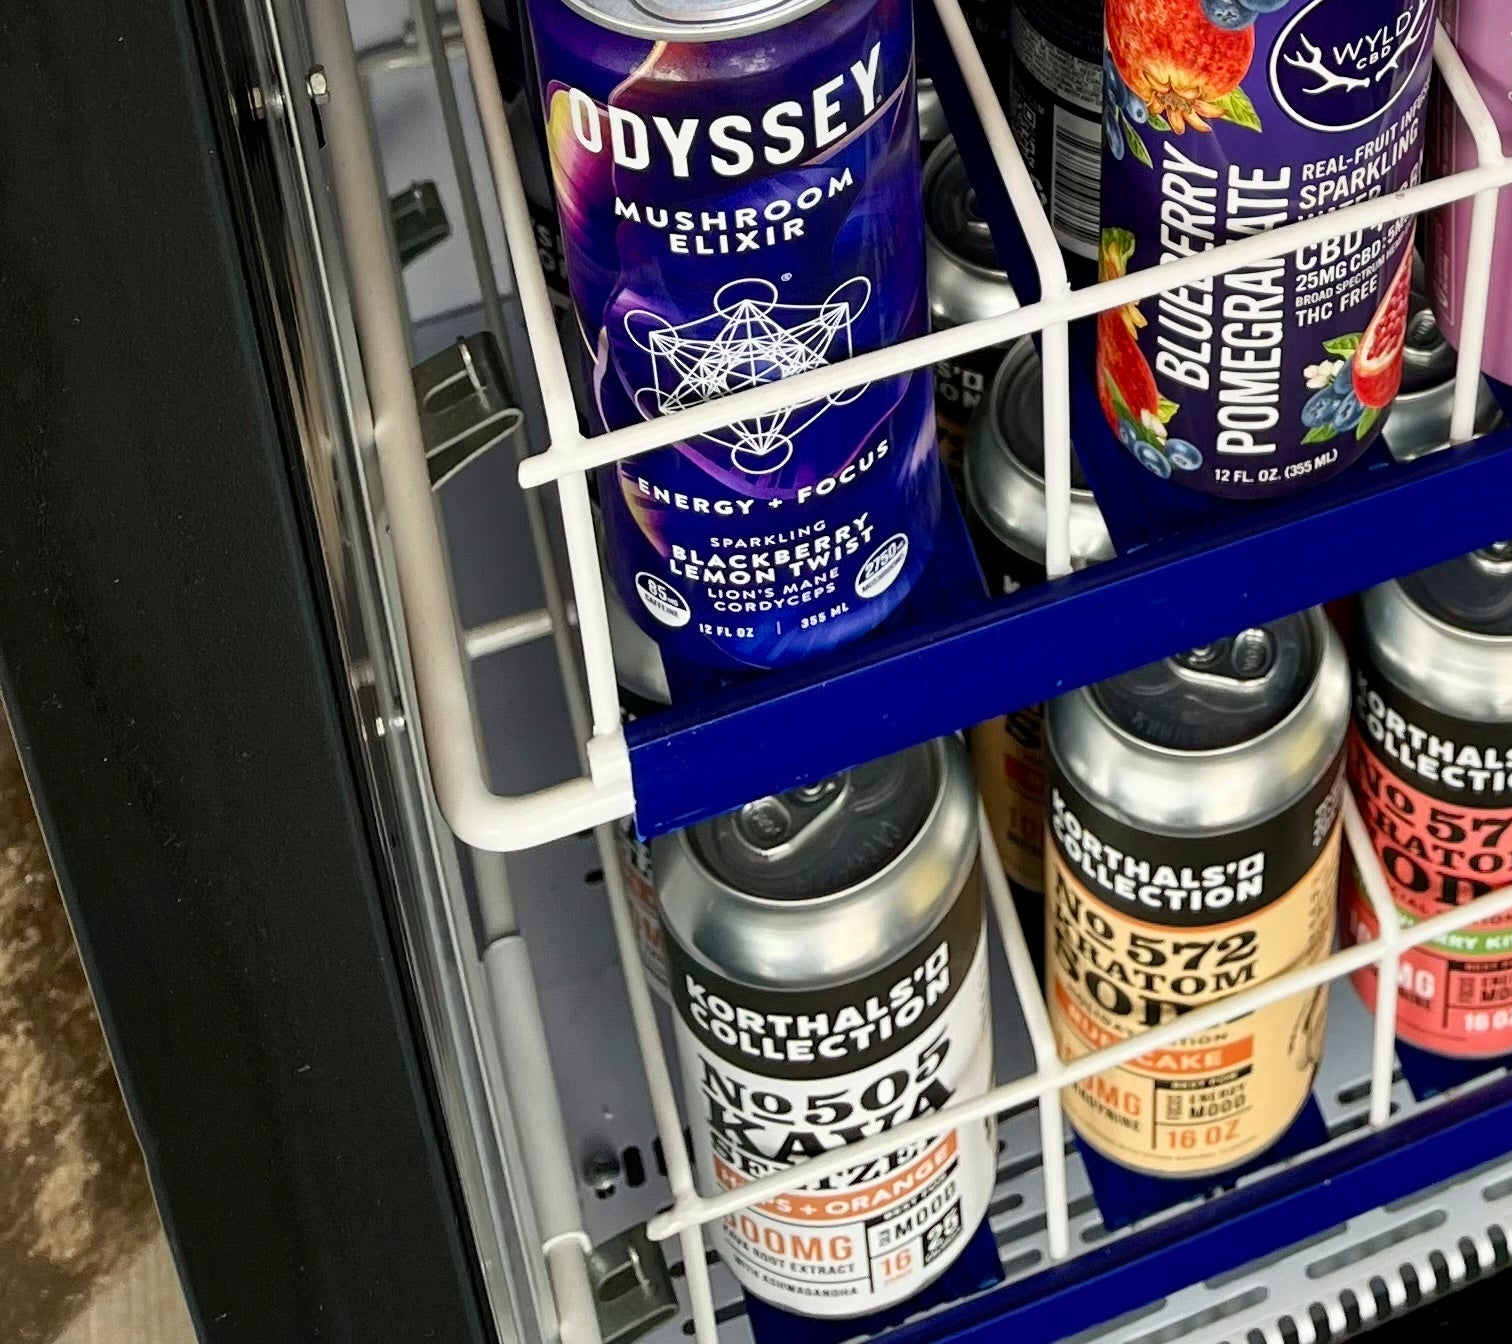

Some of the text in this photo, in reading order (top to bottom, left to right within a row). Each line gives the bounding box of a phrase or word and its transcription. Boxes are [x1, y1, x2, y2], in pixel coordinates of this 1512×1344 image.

[1331, 5, 1411, 65] WYLD
[1356, 44, 1391, 70] CBD
[568, 41, 883, 178] ODYSSEY
[1299, 119, 1418, 210] SPARKLING
[1302, 126, 1399, 182] REAL-FRUIT
[614, 167, 854, 233] MUSHROOM
[669, 217, 805, 255] ELIXIR
[1156, 140, 1219, 390] BLUEERRY
[1296, 263, 1347, 292] 25MG
[1216, 163, 1292, 456] POMEGRAATE
[1295, 285, 1334, 307] BROAD
[1295, 275, 1378, 328] THC FREE
[637, 439, 890, 516] ENERGY + FOCUS
[1215, 468, 1230, 482] 12
[1284, 459, 1312, 480] (355
[1313, 449, 1339, 470] ML)
[669, 525, 875, 585] LEMON TWIST
[671, 511, 870, 572] BLACKBERRY
[709, 519, 828, 549] SPARKLING
[706, 584, 777, 602] LION'S
[781, 566, 841, 595] MANE
[712, 582, 837, 613] CORDYCEPS
[699, 602, 850, 638] 12 FL OZ 355 ML
[1125, 929, 1259, 972] 572
[688, 965, 951, 1063] COLLECTION
[805, 1025, 953, 1128] 505
[1166, 1126, 1202, 1150] 16
[1205, 1119, 1243, 1145] OZ
[838, 1144, 951, 1217] ORANGE
[890, 1184, 960, 1243] MOOD
[880, 1251, 913, 1278] 16
